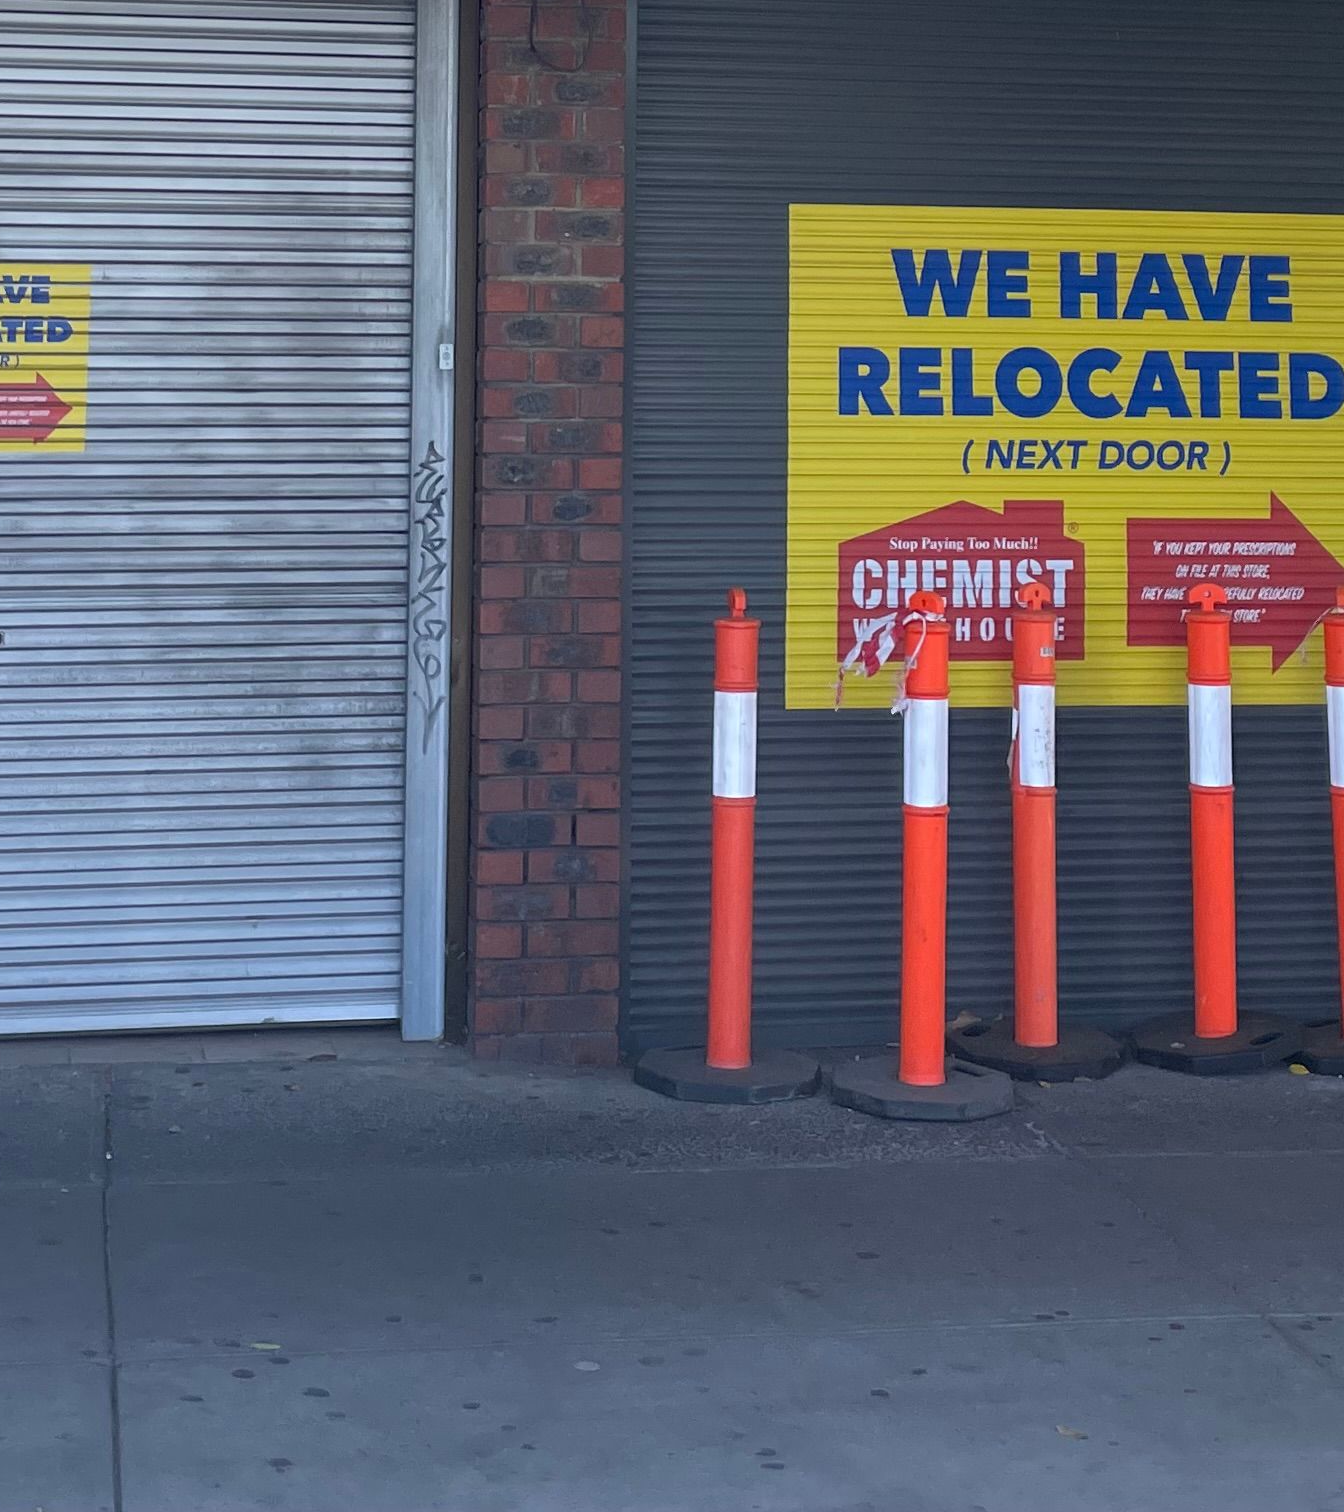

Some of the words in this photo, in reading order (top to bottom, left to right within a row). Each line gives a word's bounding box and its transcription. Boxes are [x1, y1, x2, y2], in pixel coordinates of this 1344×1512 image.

[890, 249, 1031, 318] WE
[1059, 251, 1293, 322] HAVE
[889, 536, 918, 552] Stop
[922, 537, 964, 552] Paying
[967, 537, 990, 550] Too
[993, 536, 1038, 550] Much!!
[1166, 542, 1183, 555] YOU
[1184, 542, 1207, 555] KEPT
[1208, 542, 1231, 555] YOUR
[1232, 542, 1296, 556] PRESCRIPTIONS
[1175, 564, 1187, 578] ON
[1189, 564, 1207, 578] FILE
[1209, 564, 1221, 577] AT
[1222, 564, 1241, 578] THIS
[852, 558, 1074, 610] CHEMIST
[1141, 587, 1163, 600] THEY
[1164, 587, 1187, 600] HAVE
[1258, 587, 1304, 600] RELOCATED
